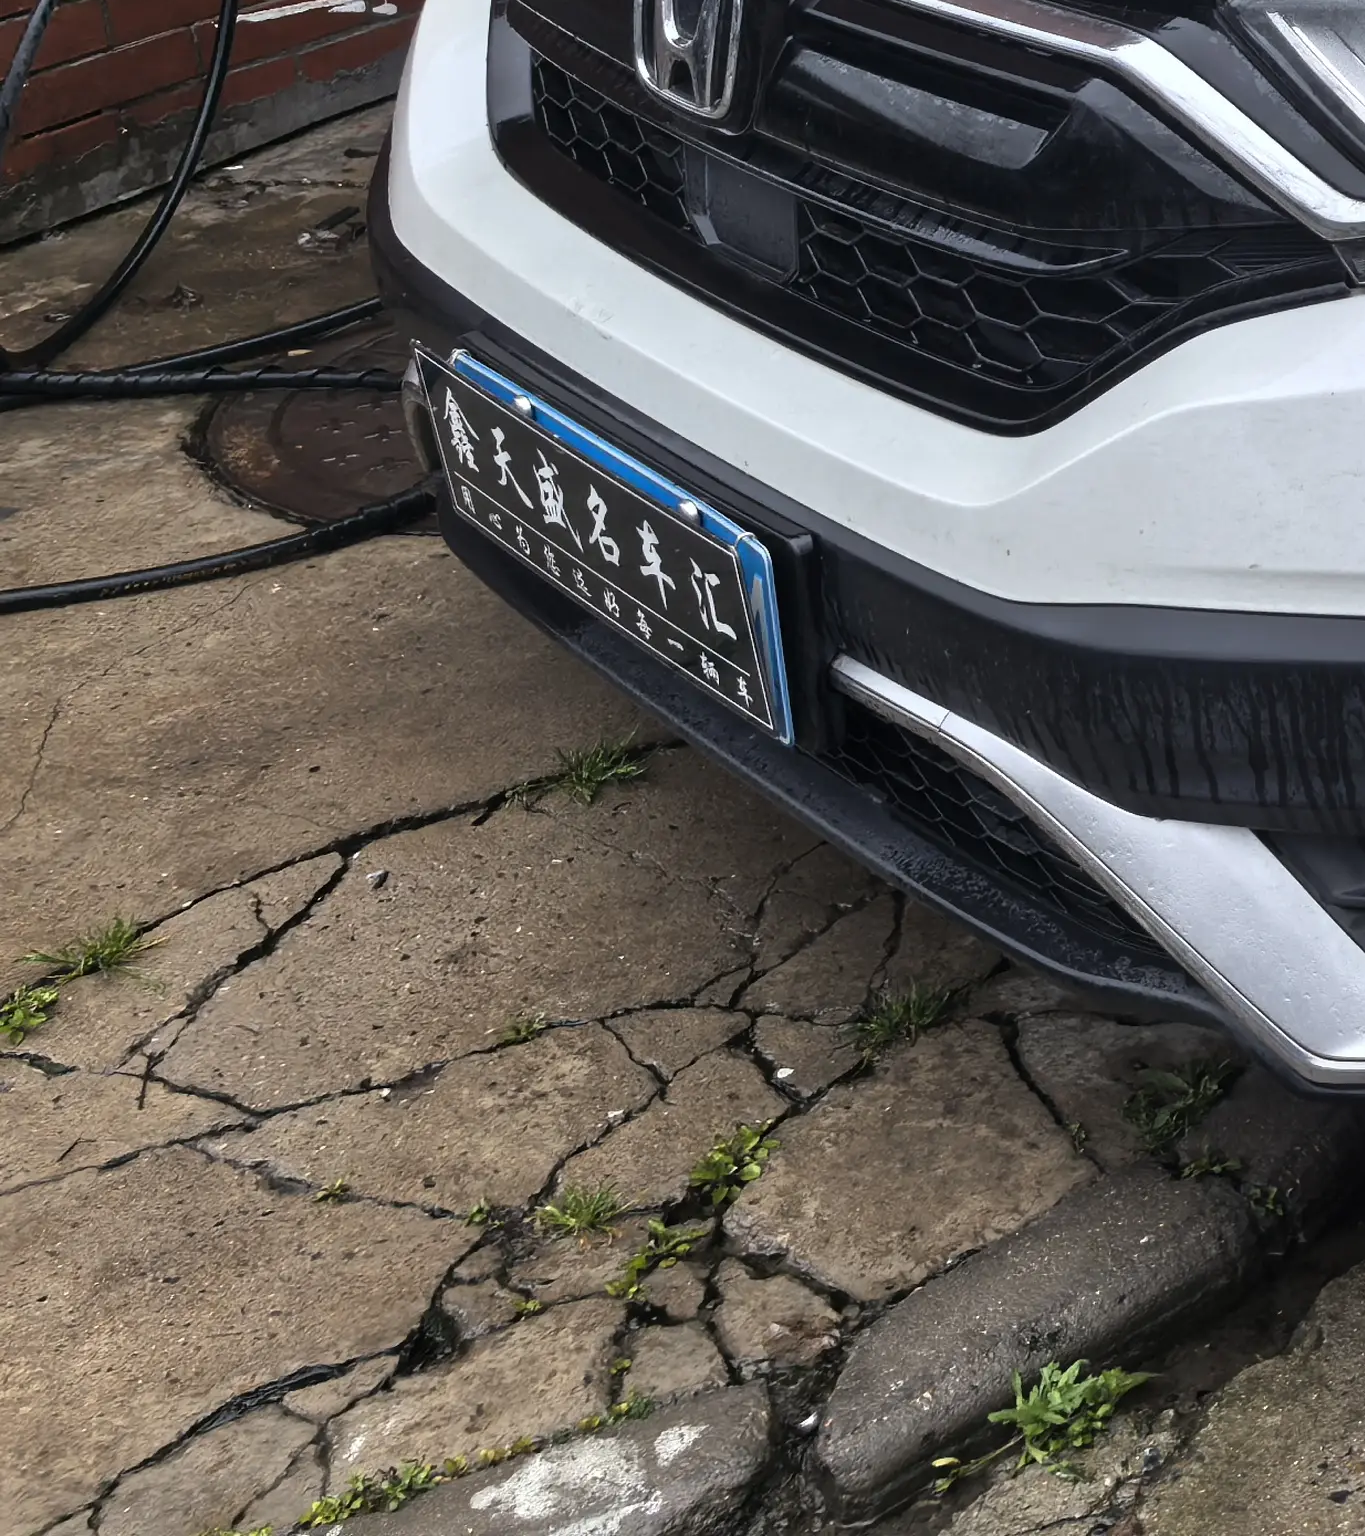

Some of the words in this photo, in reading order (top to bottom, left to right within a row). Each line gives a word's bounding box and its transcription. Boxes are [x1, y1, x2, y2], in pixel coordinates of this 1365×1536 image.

[443, 386, 737, 641] 鑫天盛名车汇
